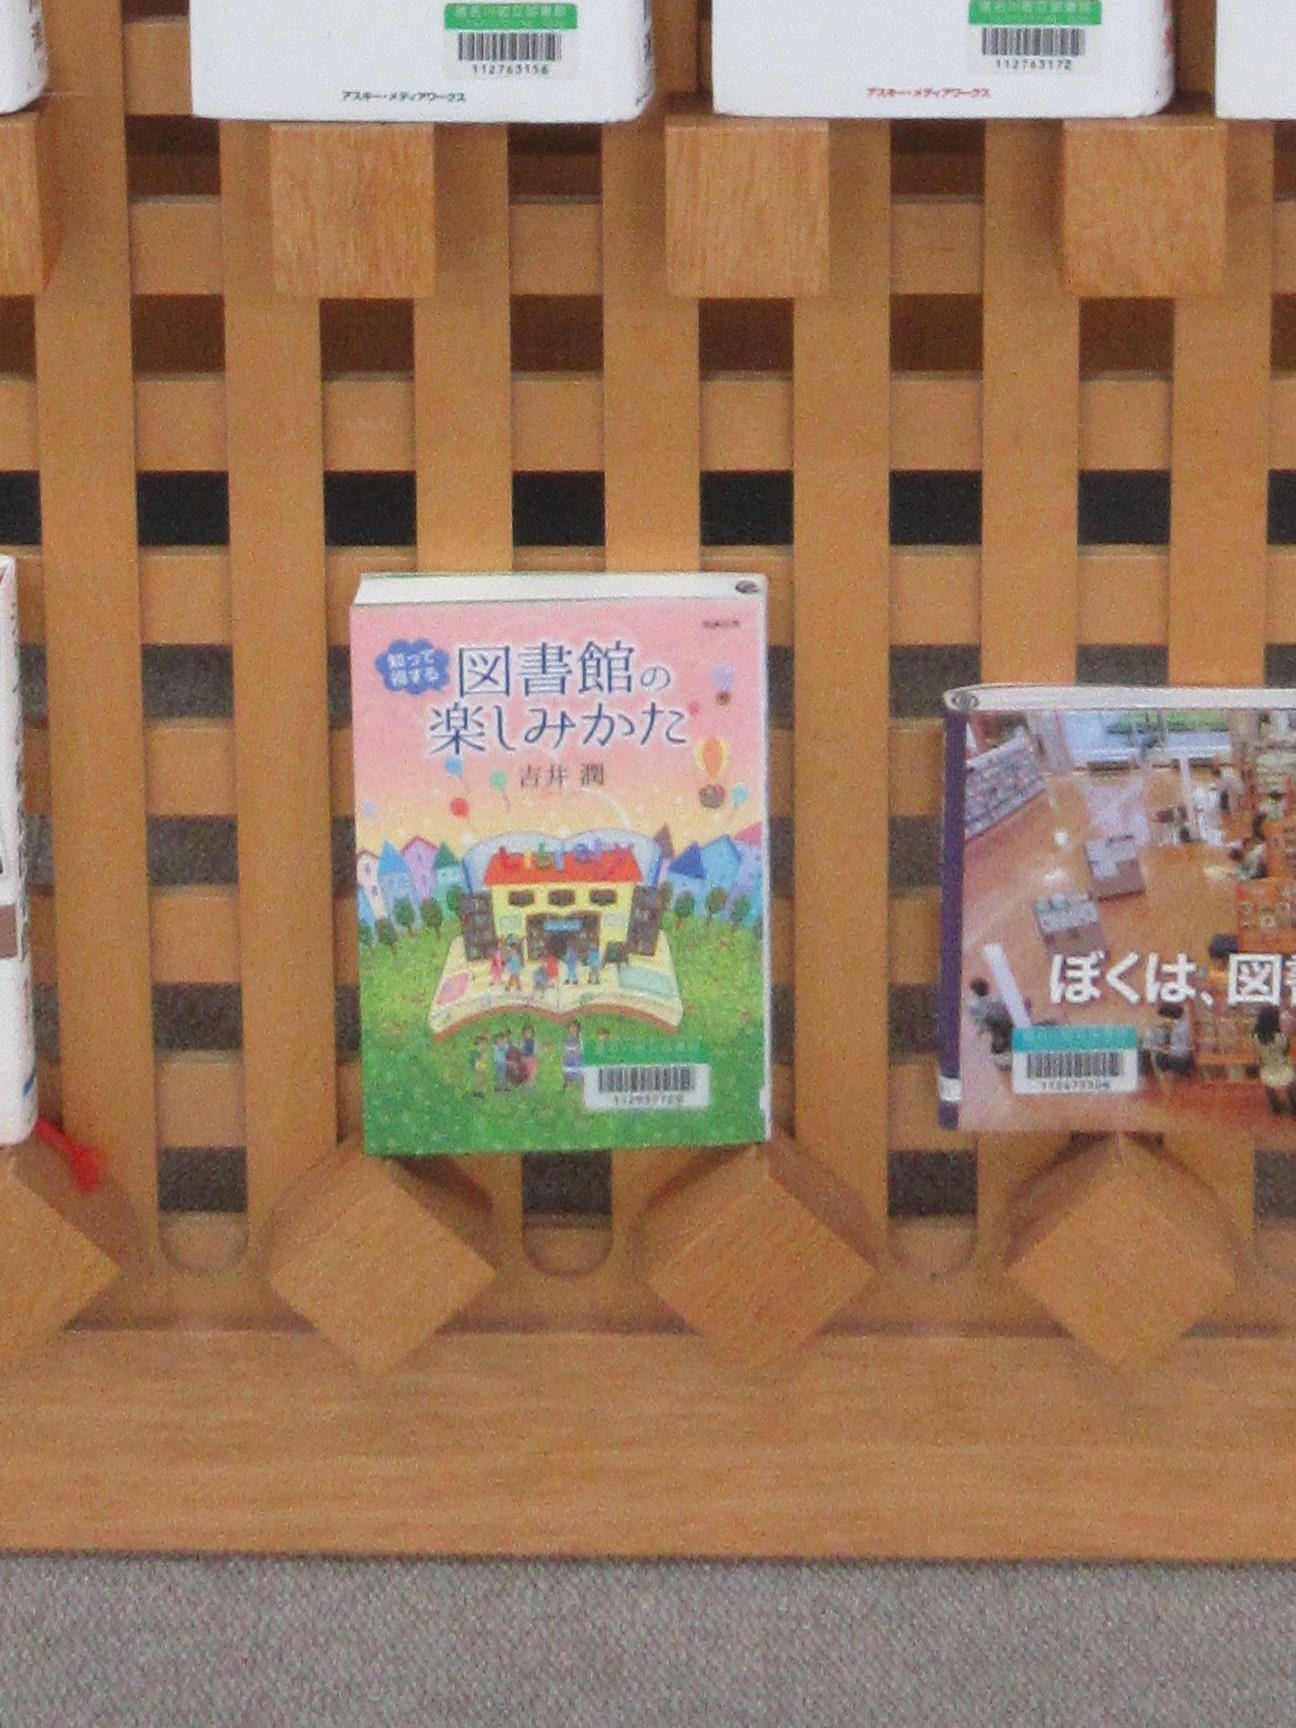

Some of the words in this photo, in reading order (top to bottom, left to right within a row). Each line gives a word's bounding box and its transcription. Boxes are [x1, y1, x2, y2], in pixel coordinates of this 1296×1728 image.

[457, 640, 673, 700] 図書館の
[428, 699, 688, 756] 楽しみかた
